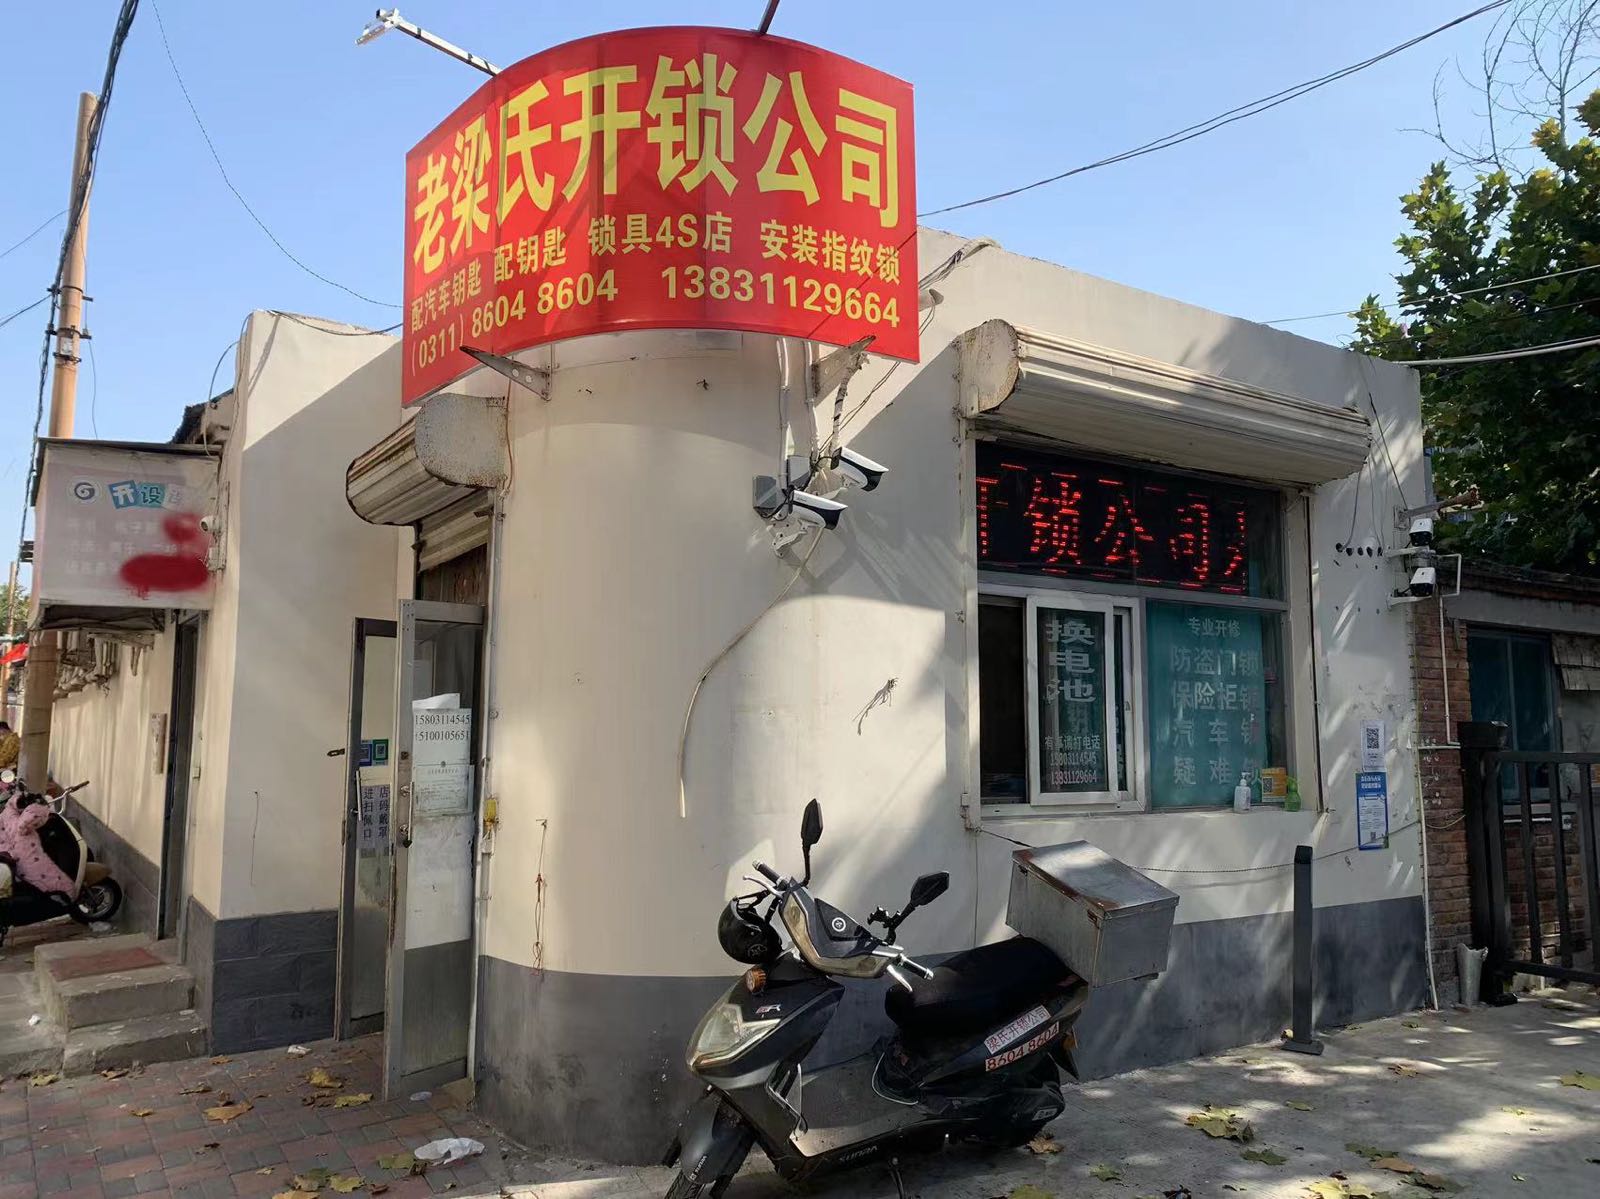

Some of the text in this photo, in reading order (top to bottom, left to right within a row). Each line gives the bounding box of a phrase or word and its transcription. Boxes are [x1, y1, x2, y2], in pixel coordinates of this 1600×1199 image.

[413, 53, 900, 275] 老梁氏开锁公司
[411, 210, 900, 334] 配汽车钥匙 配钥匙 锁具4S店 安装指纹锁
[471, 289, 527, 339] 8604
[536, 269, 619, 315] 8604
[661, 265, 900, 328] 13831129664
[1171, 646, 1260, 676] 防盗门锁
[415, 714, 470, 725] 15803114545
[986, 1021, 1060, 1071] 8604 8604
